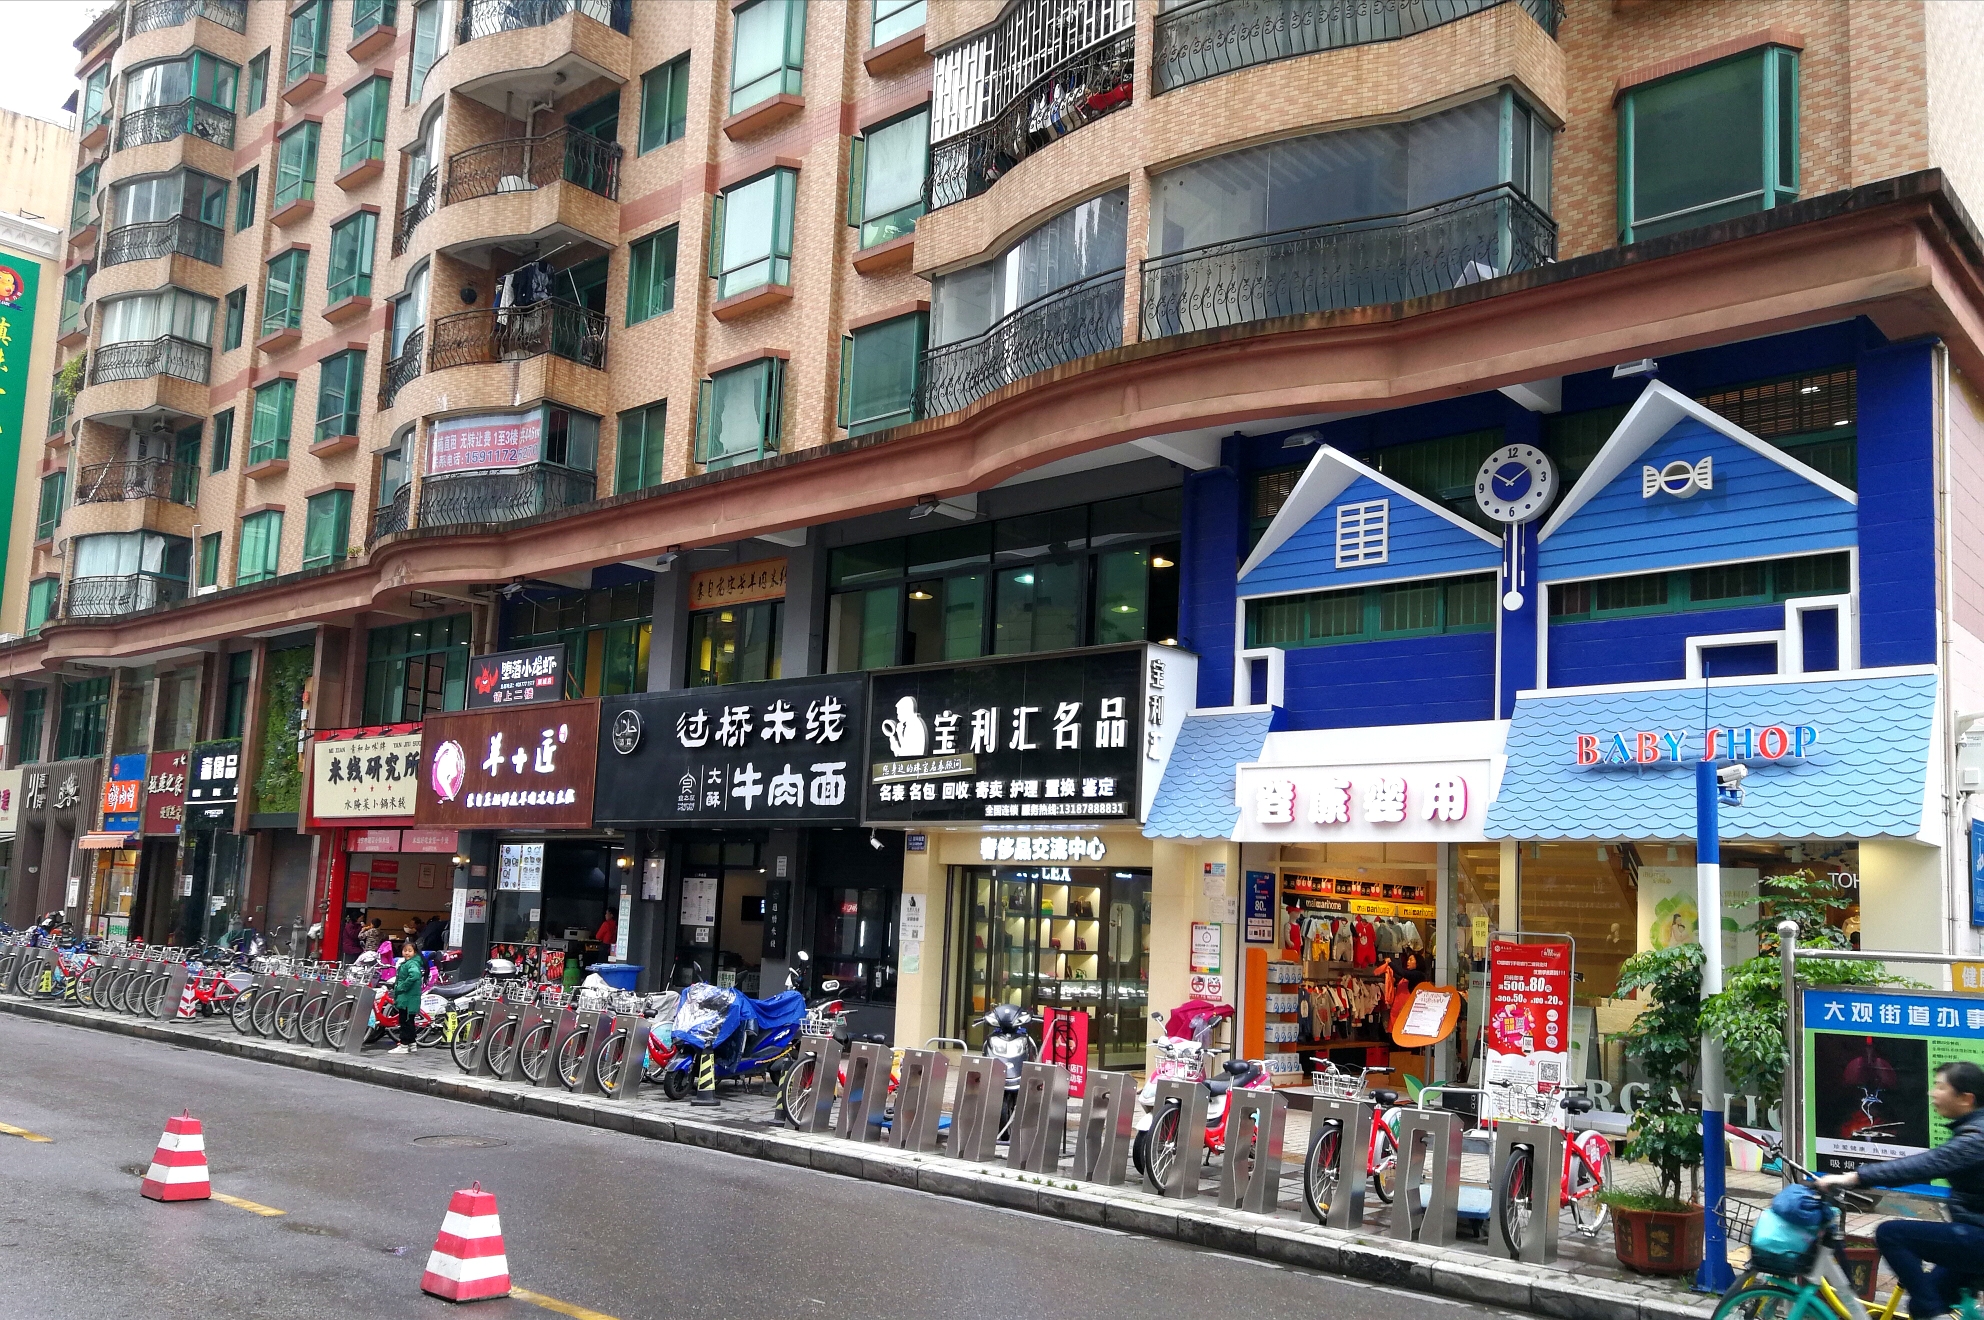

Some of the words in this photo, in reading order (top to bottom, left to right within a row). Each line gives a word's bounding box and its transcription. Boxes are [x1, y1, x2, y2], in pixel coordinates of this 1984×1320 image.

[460, 430, 491, 449] 无转让费
[494, 428, 519, 446] 1至3楼
[1508, 447, 1518, 458] 12
[1479, 483, 1484, 493] 9
[1541, 471, 1547, 482] 3
[1509, 506, 1514, 517] 6
[501, 655, 557, 680] 堕落小龙虾
[676, 695, 846, 748] 过桥米线
[933, 696, 1127, 754] 宝利汇名品
[1576, 729, 1688, 765] BABY
[1700, 725, 1819, 762] SHOP
[328, 751, 420, 785] 米线研究所
[732, 762, 846, 810] 牛肉面
[880, 784, 905, 801] 名表
[909, 782, 936, 800] 名包
[942, 781, 969, 799] 回收
[975, 778, 1003, 798] 寄卖
[1009, 779, 1039, 798] 护理
[1045, 778, 1076, 797] 置换
[1082, 776, 1114, 797] 鉴定
[985, 804, 1019, 817] 全国连锁
[1021, 802, 1124, 817] 服务热线:13187888831
[980, 836, 1106, 861] 奢侈品交流中心
